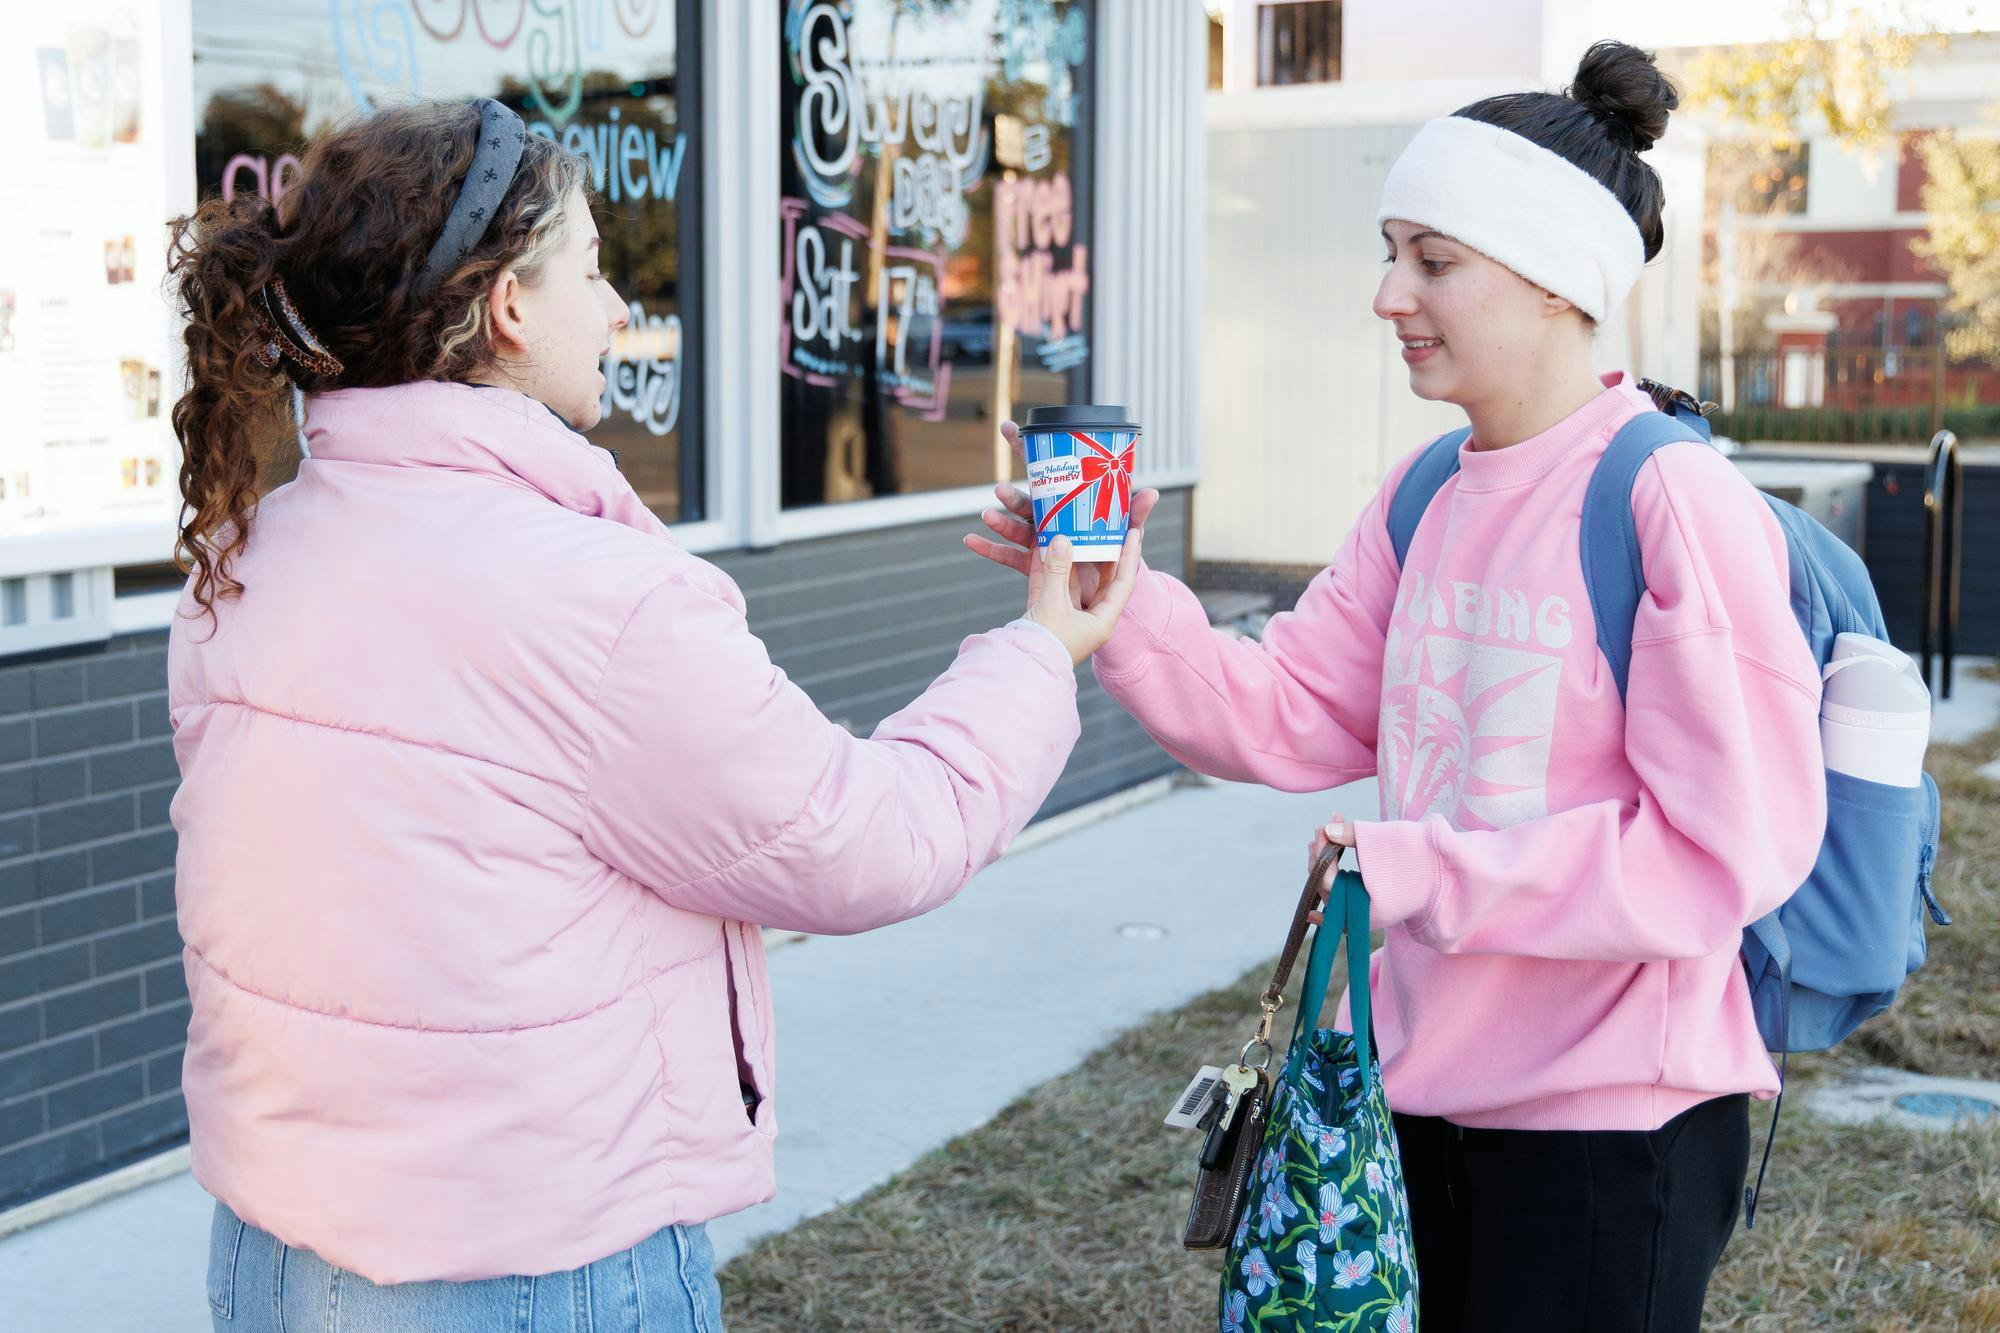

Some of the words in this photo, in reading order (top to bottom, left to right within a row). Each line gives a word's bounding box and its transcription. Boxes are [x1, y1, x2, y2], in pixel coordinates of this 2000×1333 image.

[1044, 461, 1081, 476] Holidays
[1031, 477, 1047, 489] FROM
[1048, 477, 1053, 485] 7
[1053, 473, 1080, 484] BREW
